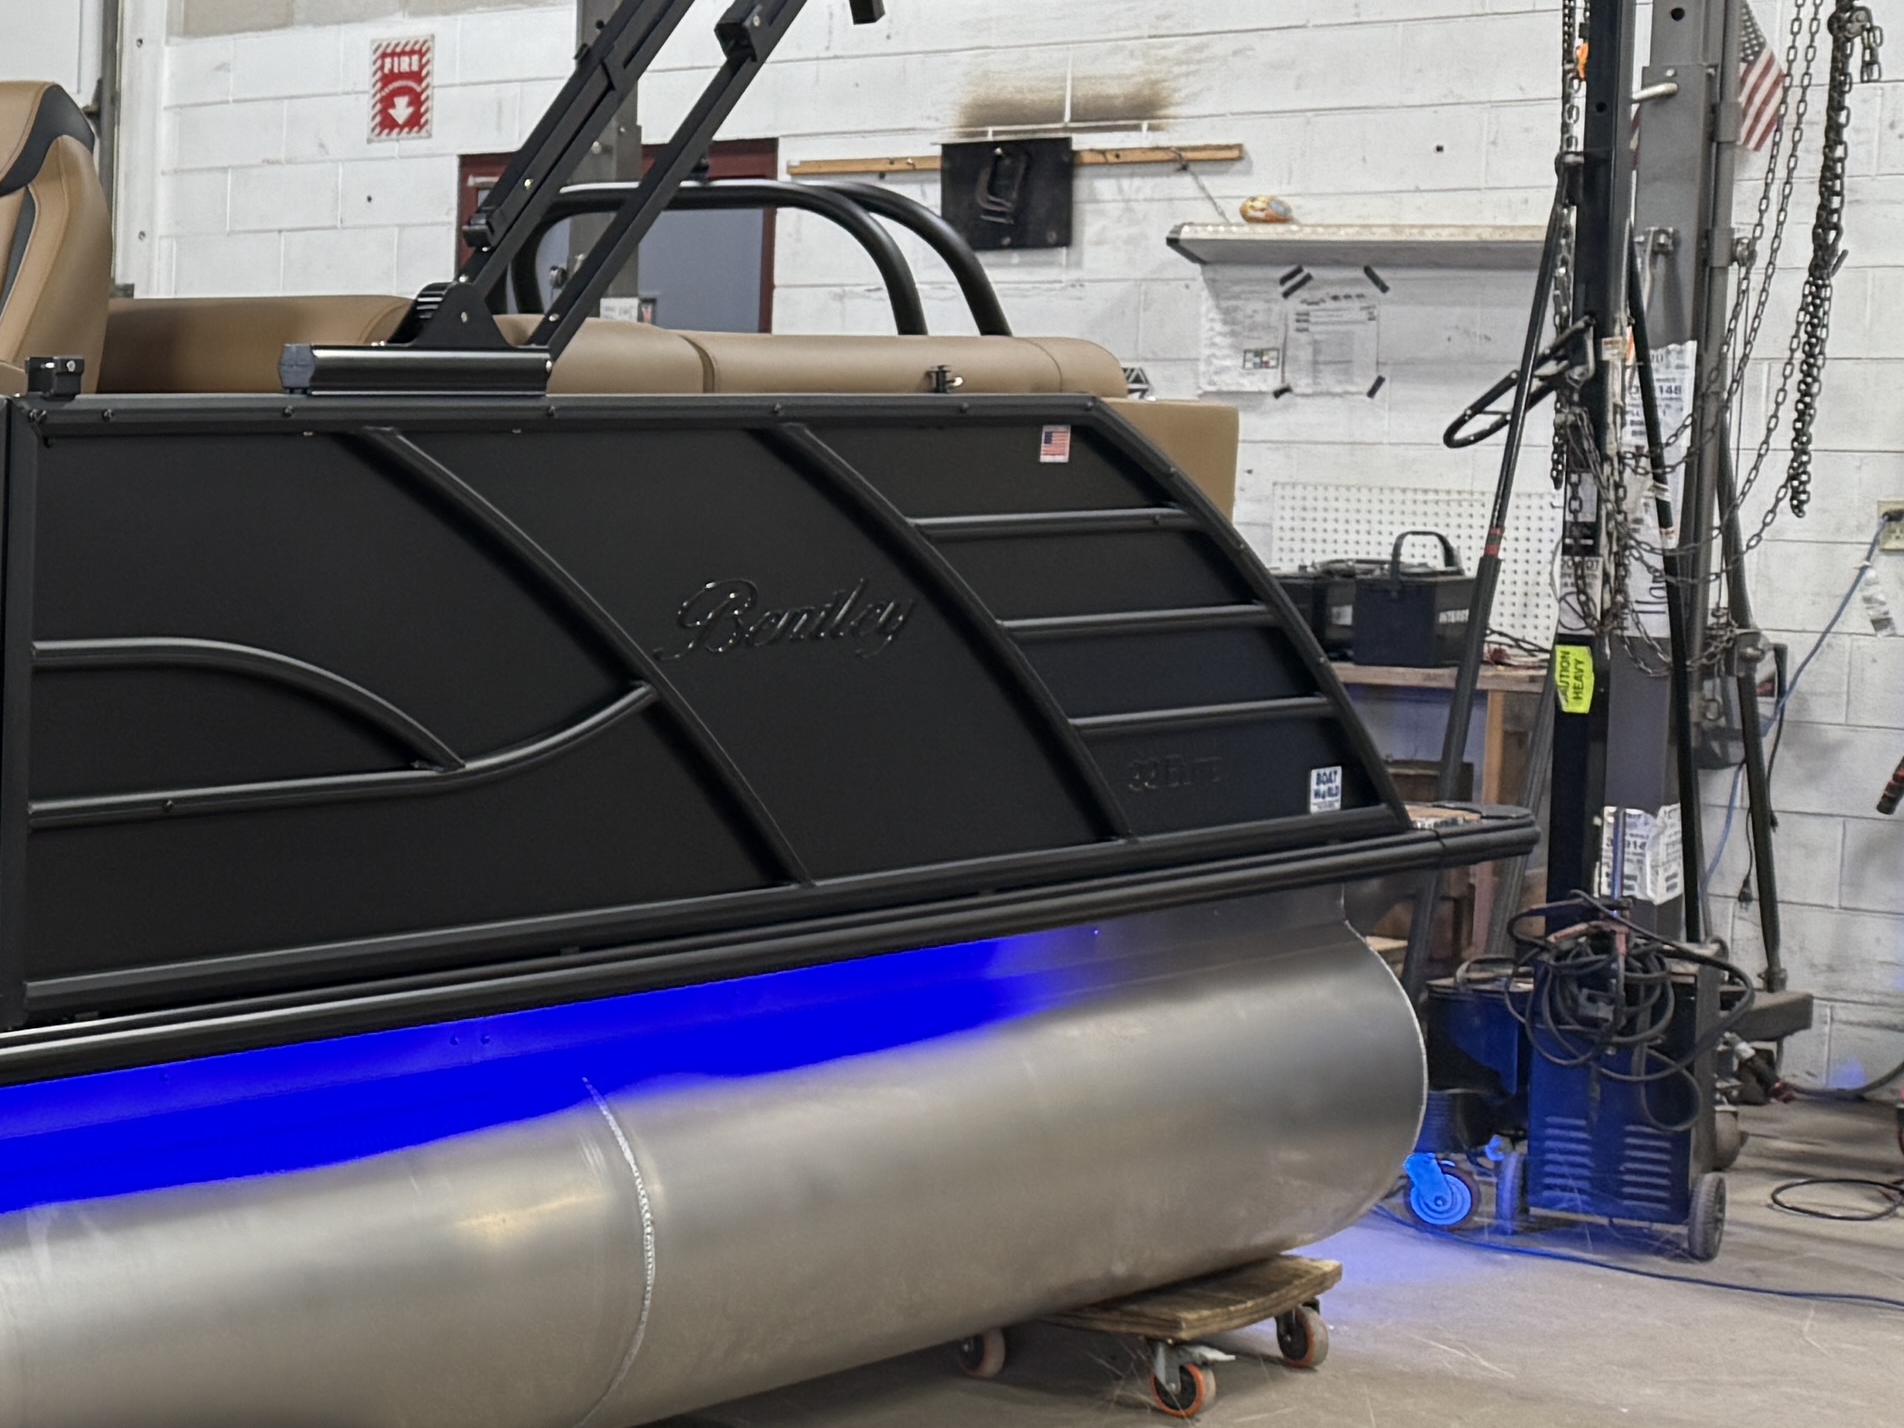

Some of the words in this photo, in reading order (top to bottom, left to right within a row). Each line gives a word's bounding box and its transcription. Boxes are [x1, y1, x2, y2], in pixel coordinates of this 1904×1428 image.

[383, 54, 421, 74] FIRE
[652, 577, 916, 660] Bentley
[1572, 658, 1584, 700] HEAVY
[1315, 770, 1338, 786] BOAT
